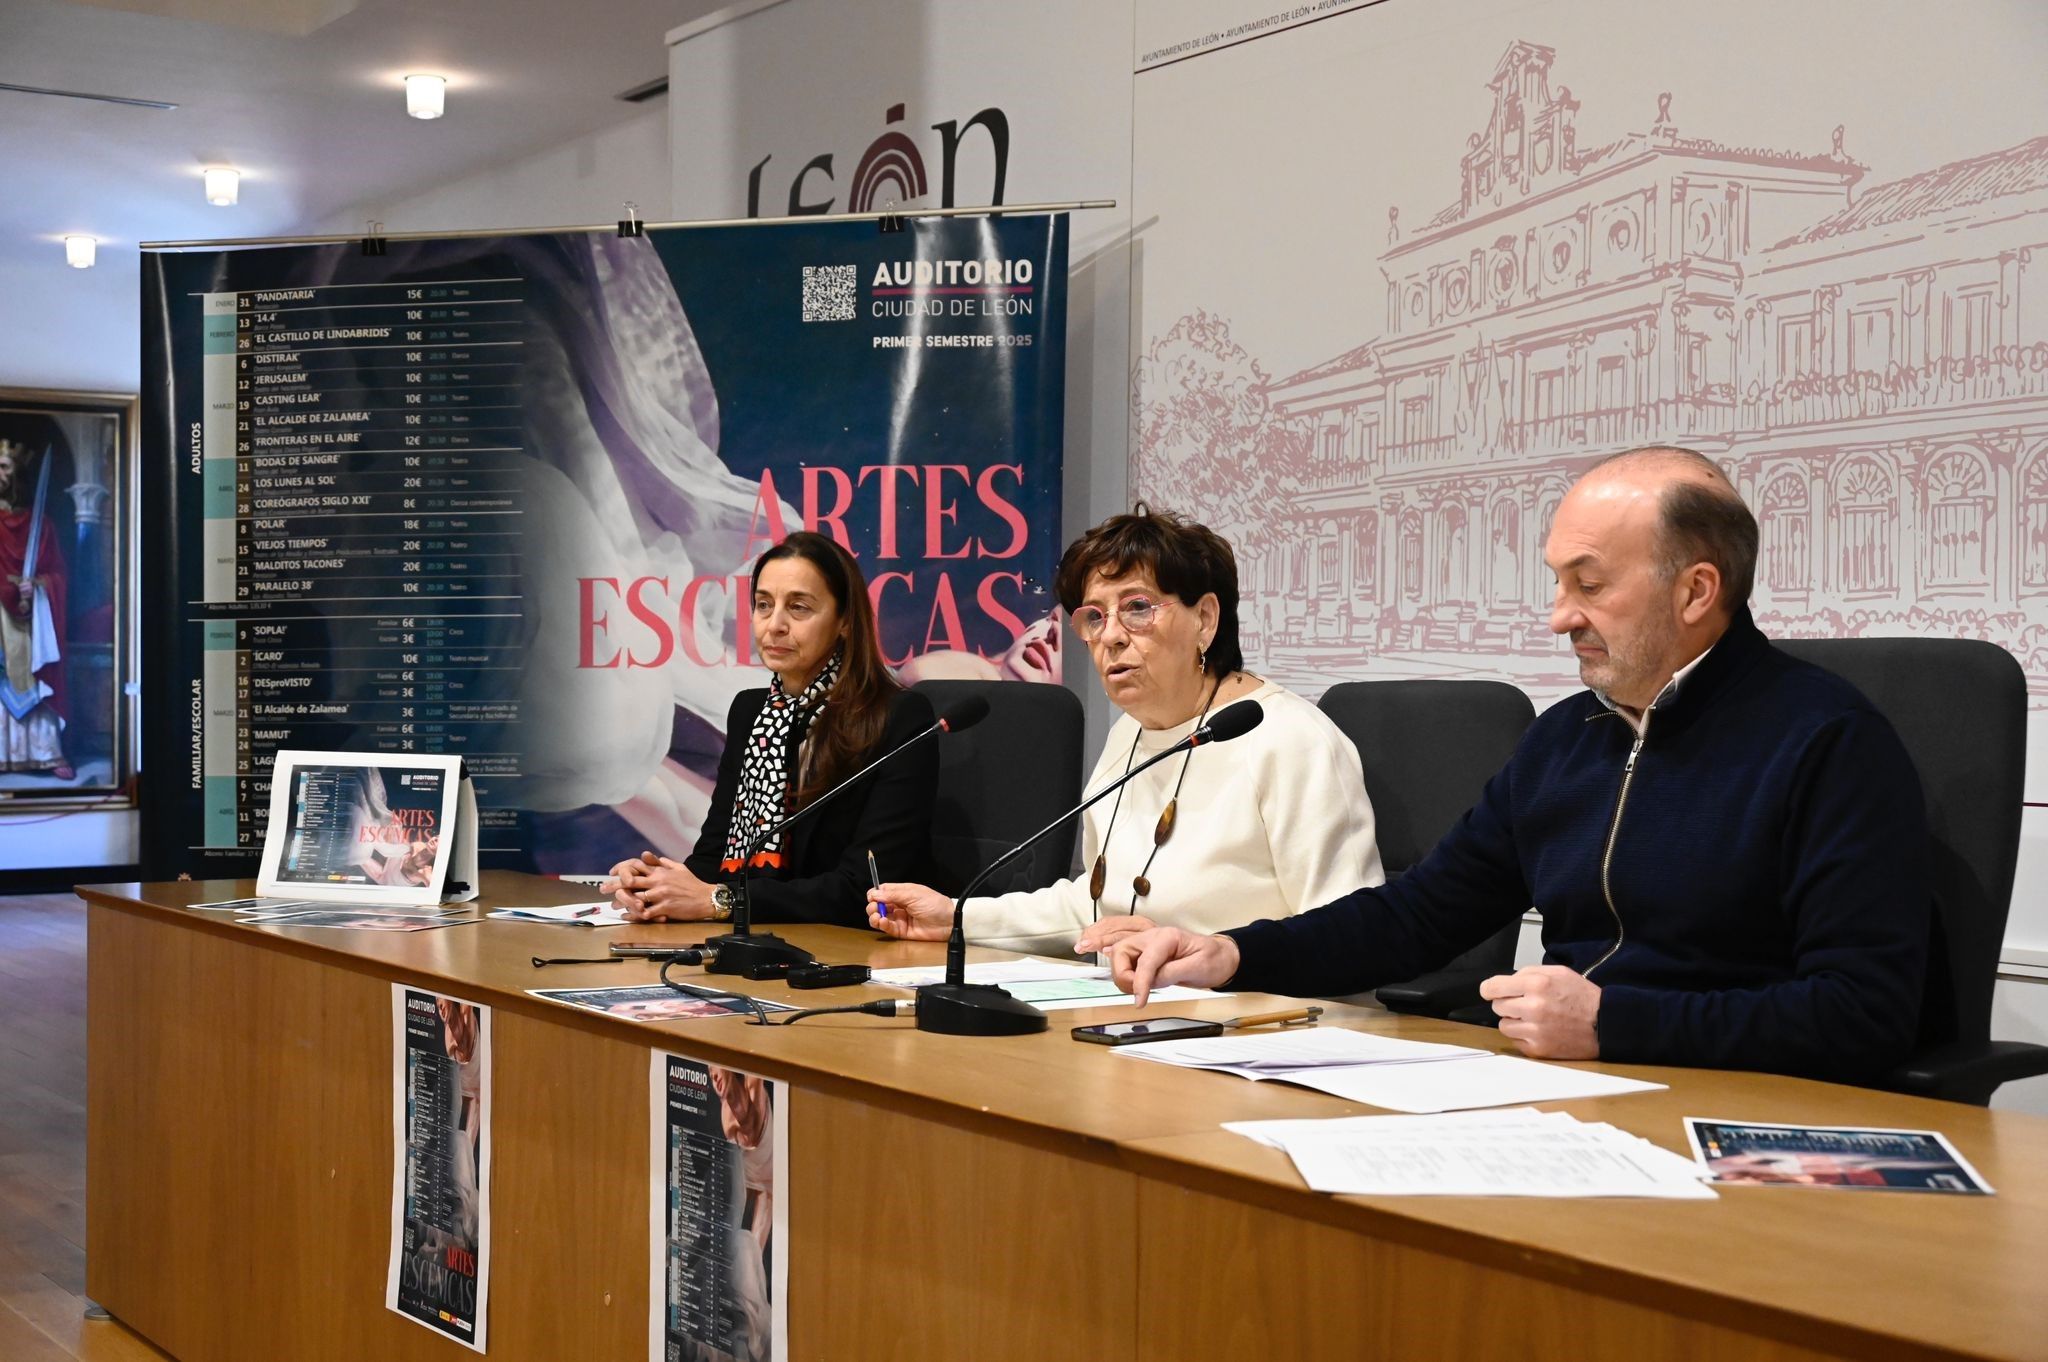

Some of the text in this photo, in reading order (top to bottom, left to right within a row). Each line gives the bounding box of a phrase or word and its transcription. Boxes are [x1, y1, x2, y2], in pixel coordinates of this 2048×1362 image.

[1142, 40, 1191, 64] AYUNTAMIENTO
[1192, 39, 1200, 48] DE
[1202, 32, 1220, 46] LEÓN
[1226, 16, 1280, 38] AYUNTAMIENTO
[1280, 12, 1290, 22] DE
[1291, 6, 1310, 20] LEÓN
[872, 259, 1033, 287] AUDITORIO
[407, 289, 422, 299] 15€
[240, 298, 250, 308] 31
[872, 294, 1032, 318] CIUDAD DE LEÓN
[406, 310, 422, 320] 10€
[240, 319, 250, 328] 13
[268, 332, 310, 342] CASTILLO
[313, 331, 324, 340] DE
[406, 331, 422, 340] 10€
[239, 339, 250, 348] 26
[873, 334, 1033, 348] PRIMER SEMESTRE 2025
[406, 352, 422, 362] 10€
[241, 360, 247, 369] 6
[406, 373, 422, 382] 10€
[239, 380, 249, 390] 12
[405, 394, 421, 404] 10€
[239, 401, 249, 410] 19
[268, 414, 306, 424] ALCALDE
[309, 414, 320, 423] DE
[405, 415, 421, 425] 10€
[239, 422, 249, 430] 21
[310, 434, 321, 443] EN
[325, 434, 334, 442] EL
[405, 436, 420, 445] 12€
[192, 422, 201, 474] ADULTOS
[239, 442, 249, 451] 26
[288, 456, 299, 465] DE
[404, 457, 420, 466] 10€
[239, 463, 249, 471] 11
[274, 477, 302, 487] LUNES
[304, 477, 316, 485] AL
[404, 478, 421, 487] 20€
[238, 484, 249, 492] 24
[322, 496, 348, 506] SIGLO
[403, 499, 416, 508] 8€
[238, 505, 249, 513] 28
[743, 464, 1030, 561] ARTES
[403, 520, 420, 529] 18€
[240, 525, 246, 534] 8
[238, 546, 248, 554] 15
[403, 541, 421, 550] 20€
[238, 567, 248, 575] 21
[403, 562, 420, 571] 20€
[238, 587, 248, 596] 29
[403, 583, 419, 592] 10€
[402, 618, 414, 628] 6€
[240, 630, 246, 640] 9
[402, 634, 414, 644] 3€
[241, 657, 246, 665] 2
[402, 654, 418, 664] 10€
[238, 677, 248, 685] 16
[402, 672, 414, 681] 6€
[238, 689, 248, 698] 17
[402, 688, 414, 697] 3€
[238, 709, 248, 718] 21
[264, 705, 294, 714] Alcalde
[296, 704, 307, 713] de
[402, 708, 414, 717] 3€
[238, 728, 248, 737] 23
[402, 724, 414, 733] 6€
[192, 679, 202, 789] FAMILIAR/ESCOLAR
[238, 741, 248, 750] 24
[402, 740, 414, 749] 3€
[238, 761, 248, 770] 25
[241, 780, 246, 789] 6
[241, 793, 246, 801] 7
[239, 813, 249, 821] 11
[391, 809, 435, 827] ARTES
[240, 833, 249, 842] 27
[408, 998, 436, 1013] AUDITORIO
[669, 1065, 708, 1086] AUDITORIO
[669, 1083, 707, 1101] CIUDAD DE LEÓN
[447, 1246, 474, 1278] ARTES
[403, 1252, 474, 1316] ESCÉNICAS
